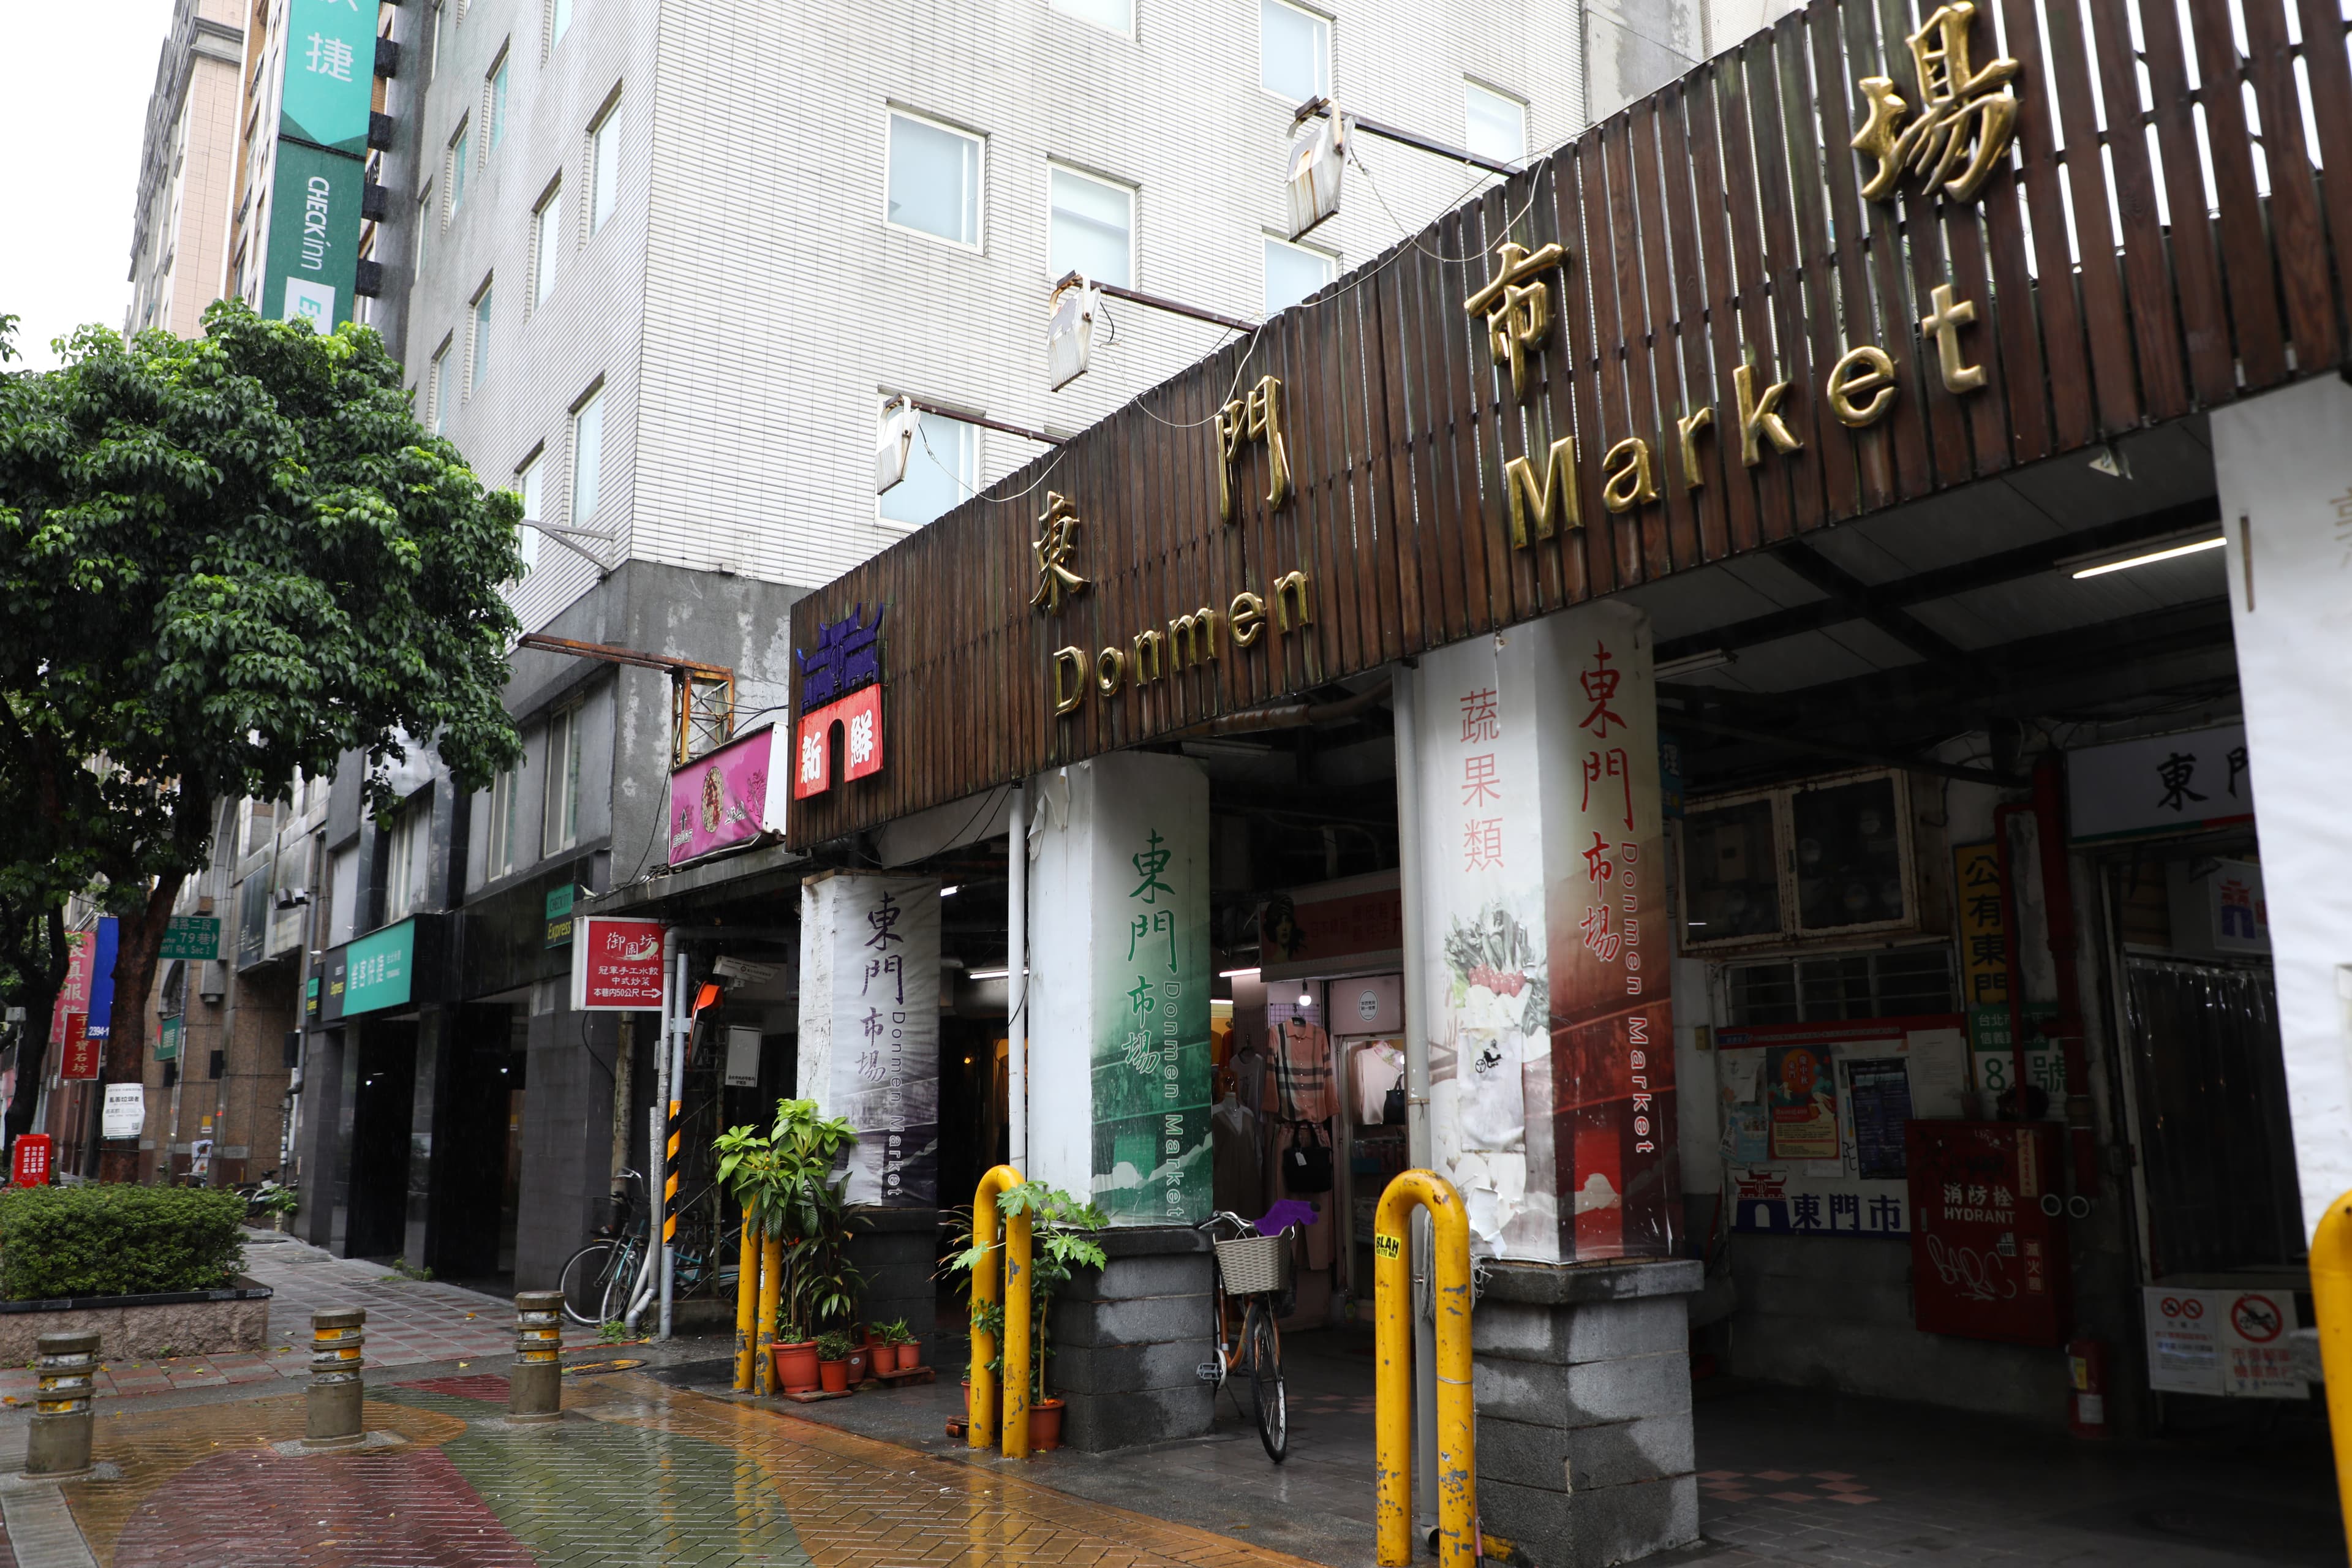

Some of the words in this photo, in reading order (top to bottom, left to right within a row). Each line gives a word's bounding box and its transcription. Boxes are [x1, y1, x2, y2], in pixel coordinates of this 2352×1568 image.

[1054, 570, 1313, 717] Donmen
[1505, 283, 1988, 549] Market
[800, 709, 873, 785] 新鮮
[1460, 687, 1504, 872] 蔬果類
[1579, 639, 1634, 962] 東門市場
[547, 921, 571, 943] Express
[1123, 827, 1178, 1074] 東門市場
[1621, 842, 1642, 995] Donmen
[593, 987, 640, 998] 本巷內50公尺
[598, 966, 659, 976] 冠軍手工水餃
[612, 976, 650, 986] 中式炒菜
[855, 891, 904, 1084] 東門市場
[889, 1011, 906, 1103] Donmen
[1163, 982, 1181, 1098] Donmen
[1628, 1017, 1654, 1153] Market
[888, 1115, 905, 1196] Market
[1165, 1114, 1183, 1217] Market
[1943, 1182, 2015, 1207] 消防栓
[1376, 1236, 1400, 1254] BLAH
[1790, 1193, 1902, 1231] 東門市
[1944, 1207, 2016, 1224] HYDRANT
